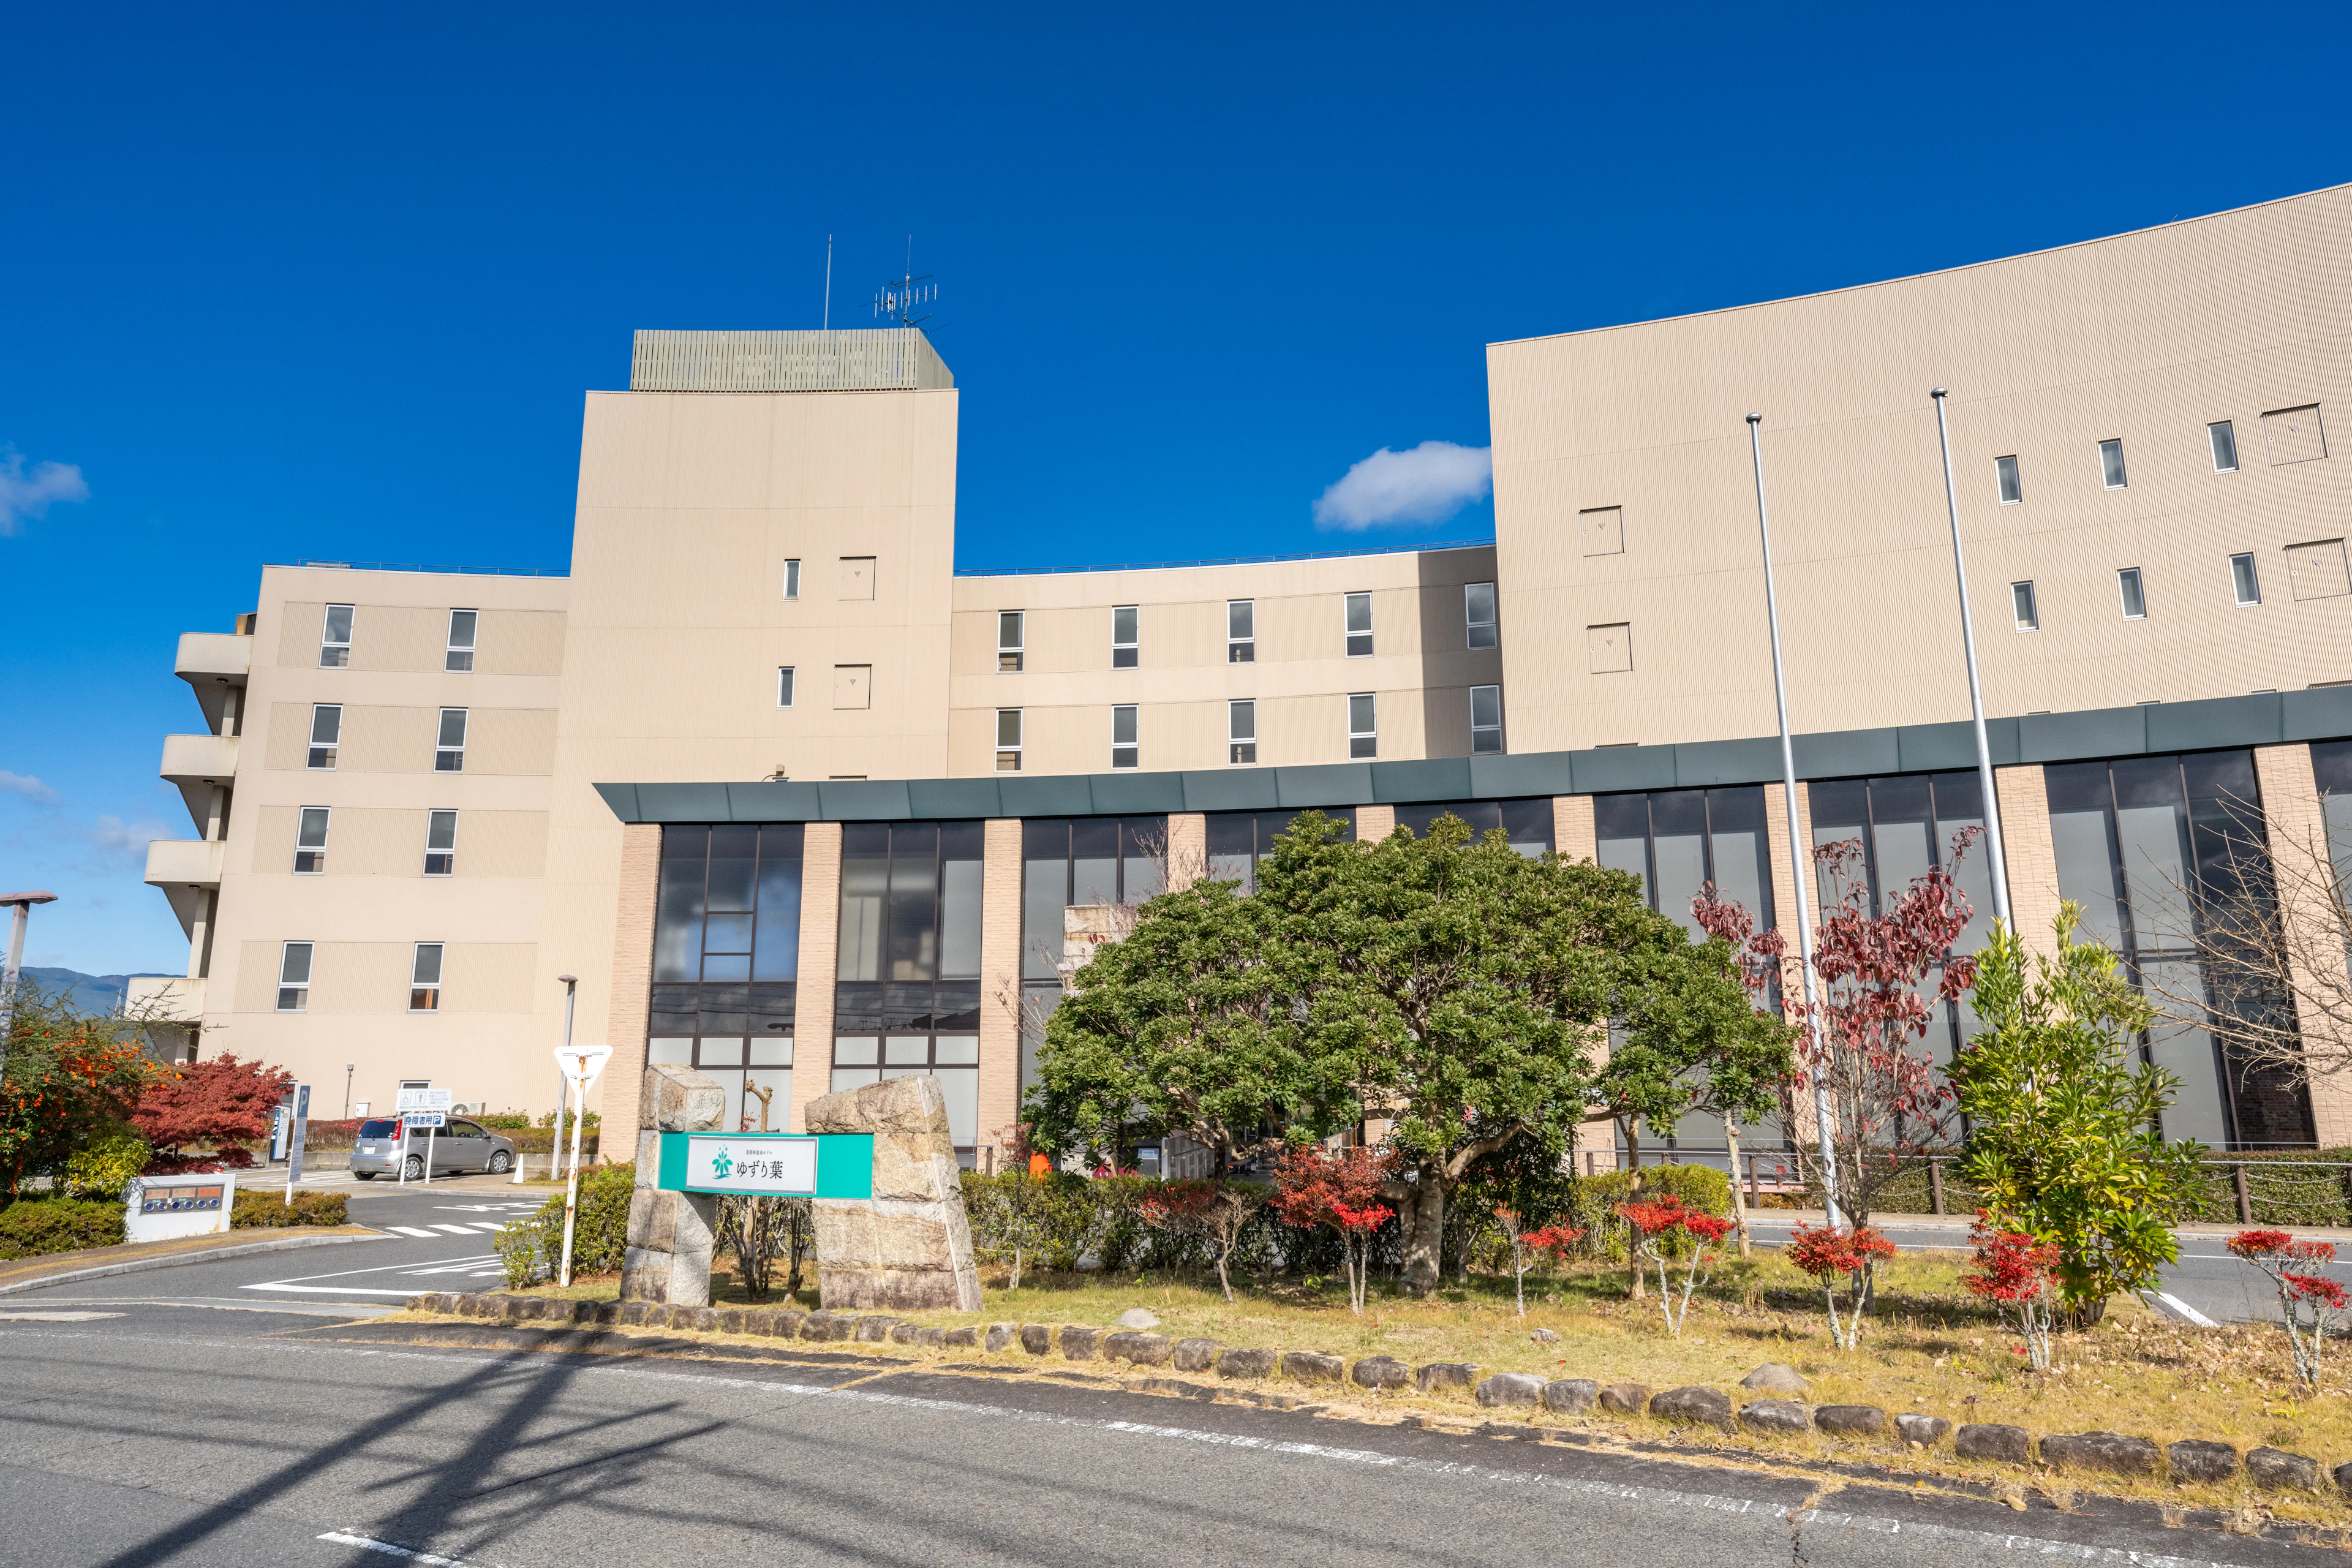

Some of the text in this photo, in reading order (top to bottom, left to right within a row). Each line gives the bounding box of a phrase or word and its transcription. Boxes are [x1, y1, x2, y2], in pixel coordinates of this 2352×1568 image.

[299, 1090, 307, 1112] P
[737, 1159, 783, 1179] ゆずり葉
